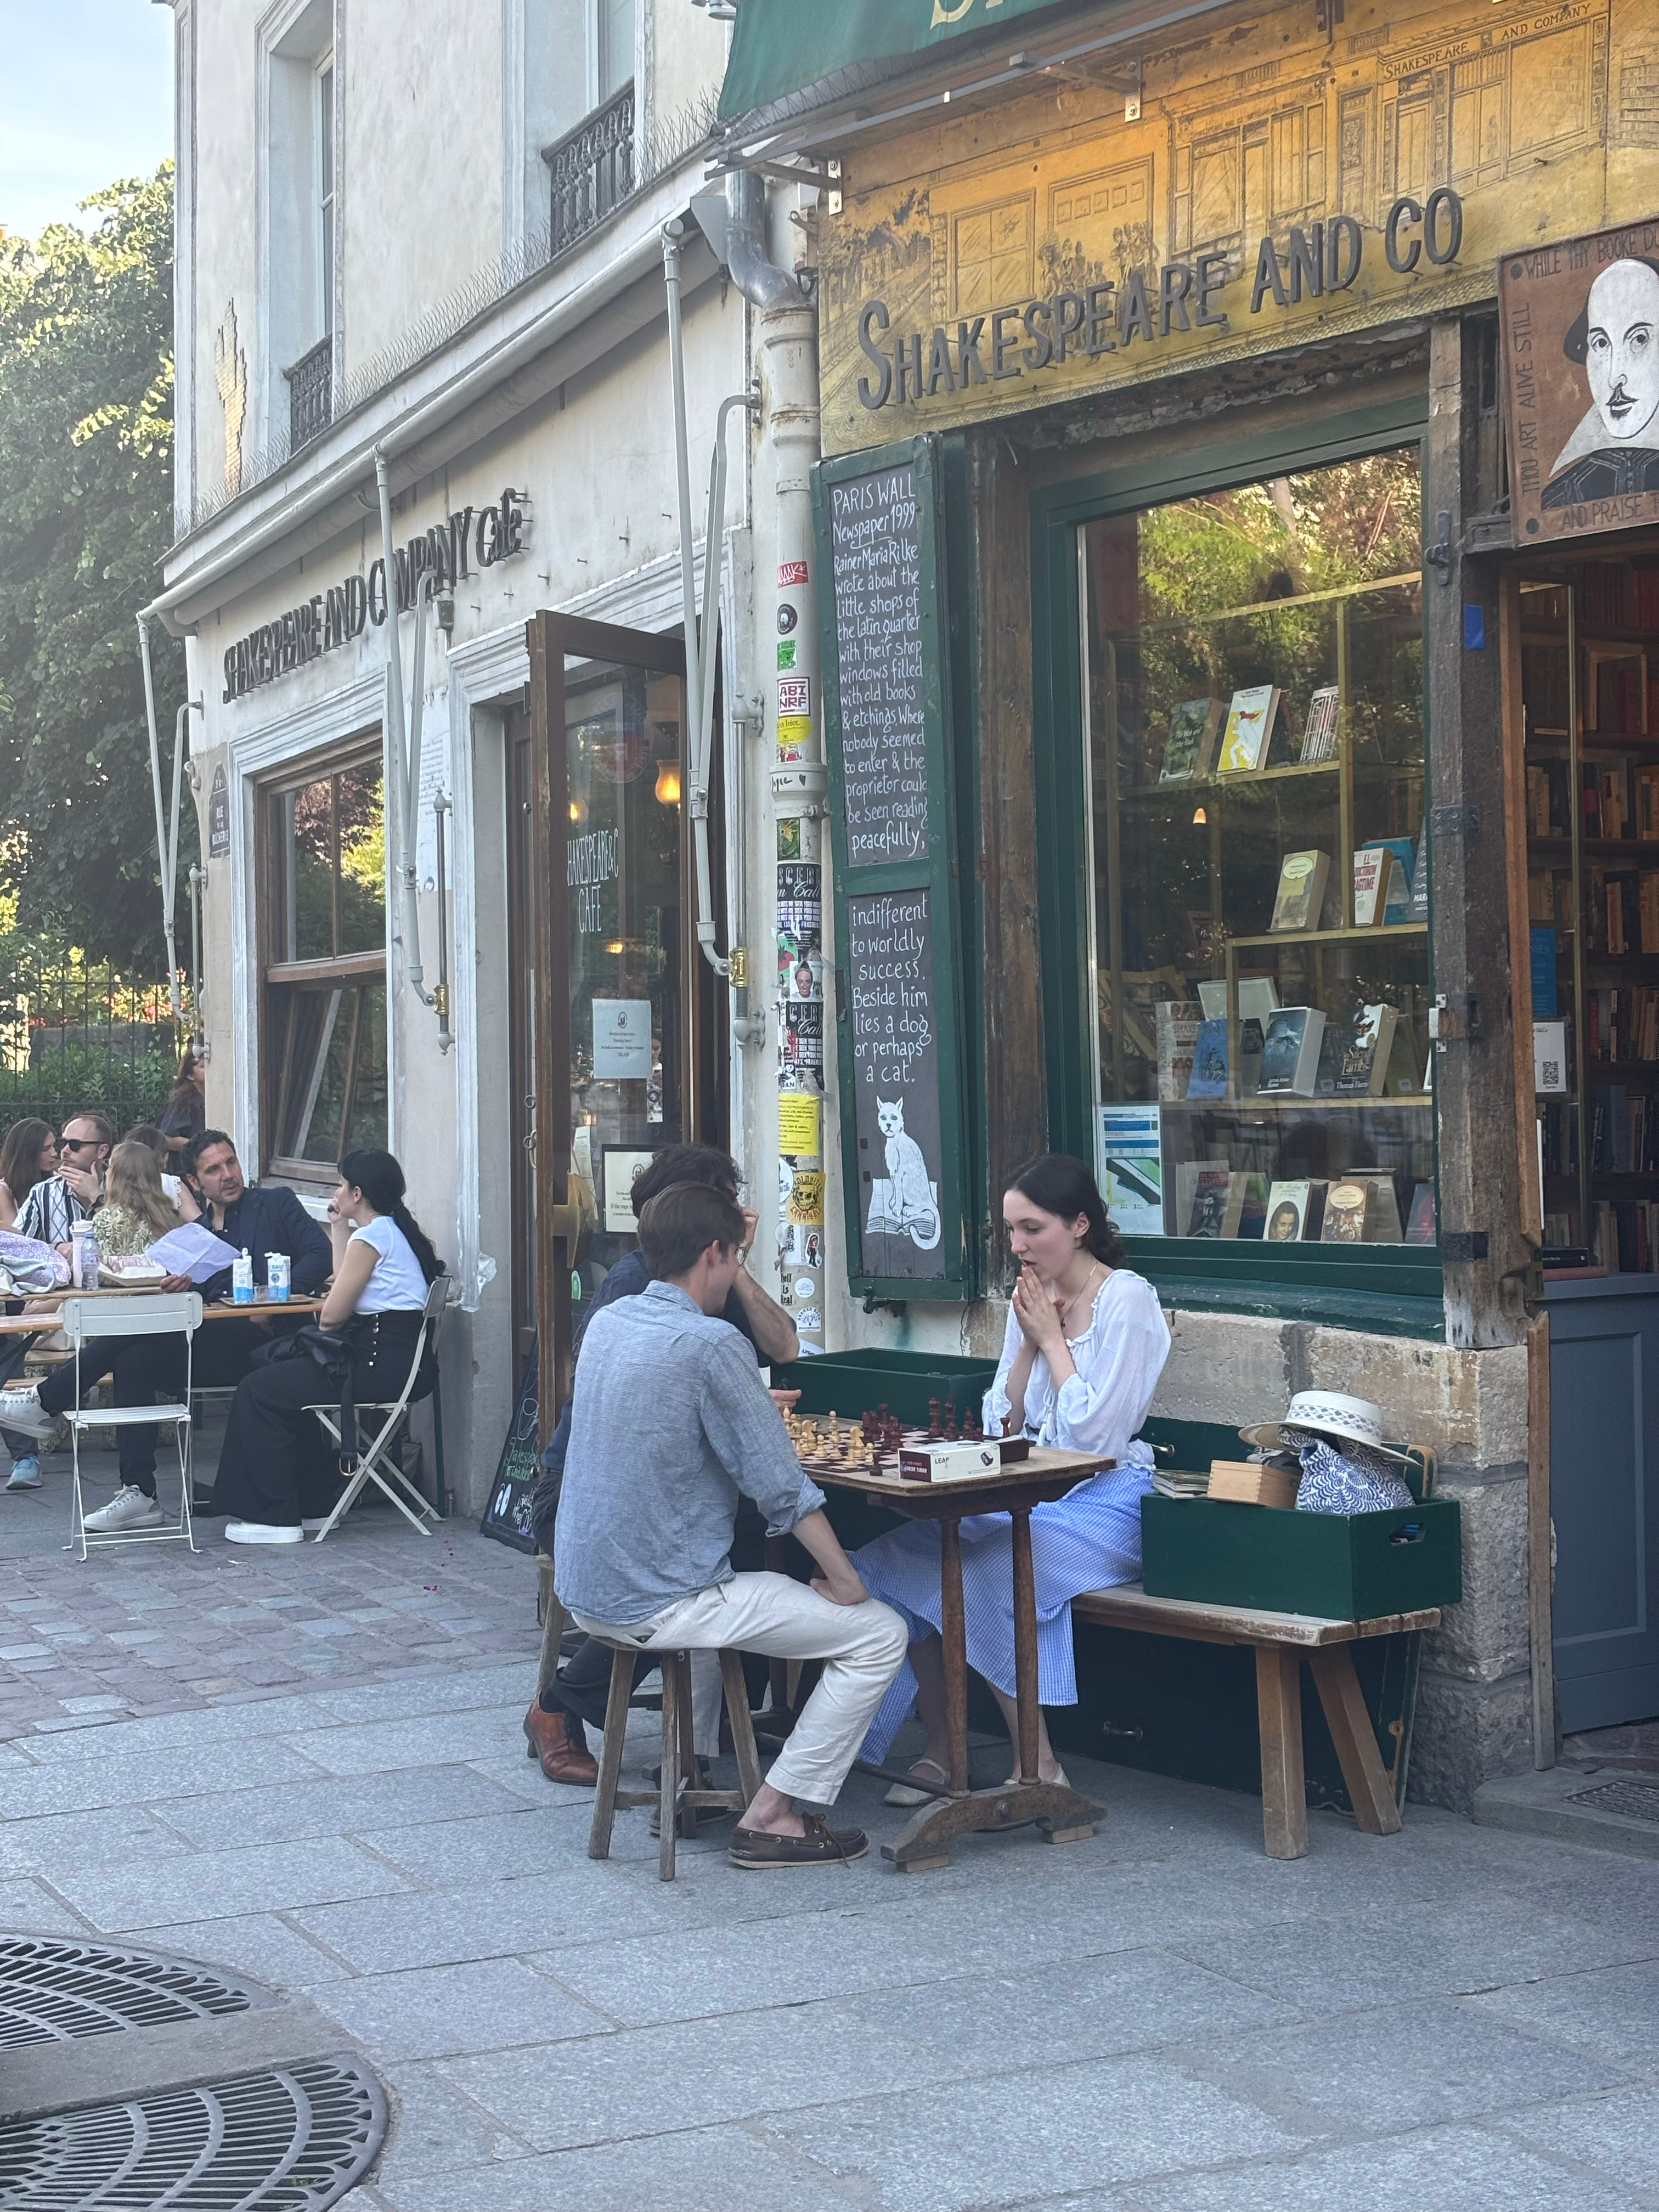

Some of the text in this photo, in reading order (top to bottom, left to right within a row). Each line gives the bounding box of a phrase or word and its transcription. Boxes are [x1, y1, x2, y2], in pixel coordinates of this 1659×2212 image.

[1384, 3, 1590, 80] SHAKESPEARE AND COMPANY
[1523, 249, 1562, 279] WHILE
[1567, 241, 1590, 270] THY
[1596, 230, 1638, 264] BOOKE
[857, 187, 1464, 409] SHAKESPEARE AND CO
[1513, 302, 1541, 497] THOU ART ALIVE STILL
[833, 472, 916, 516] PARIS WALL
[833, 501, 916, 547] Newspaper 1999
[1561, 504, 1588, 529] AND
[1592, 495, 1644, 526] PRAISE
[834, 552, 861, 576] Rainer
[861, 547, 888, 572] Maria
[888, 538, 919, 566] Rilke
[323, 574, 367, 652] AND
[368, 506, 475, 627] CMPANY
[834, 573, 865, 596] wrote
[868, 567, 897, 590] about
[901, 564, 920, 587] the
[837, 587, 919, 619] little shops of
[837, 613, 921, 643] the latin quarter
[838, 633, 922, 663] with their shop
[839, 656, 923, 686] windows filled
[840, 680, 916, 708] with old books
[842, 710, 851, 732] &
[899, 704, 925, 725] Where
[842, 726, 926, 755] nobody seemed
[844, 750, 926, 774] to enter & the
[847, 771, 927, 805] proprietor could
[847, 795, 929, 830] be seen reading
[852, 893, 928, 929] indifferent
[851, 927, 925, 960] to worldly
[858, 960, 926, 981] success.
[852, 981, 928, 1009] Beside him
[854, 1009, 933, 1046] lies a dog
[854, 1034, 924, 1064] or perhaps
[865, 1059, 916, 1084] a cat.
